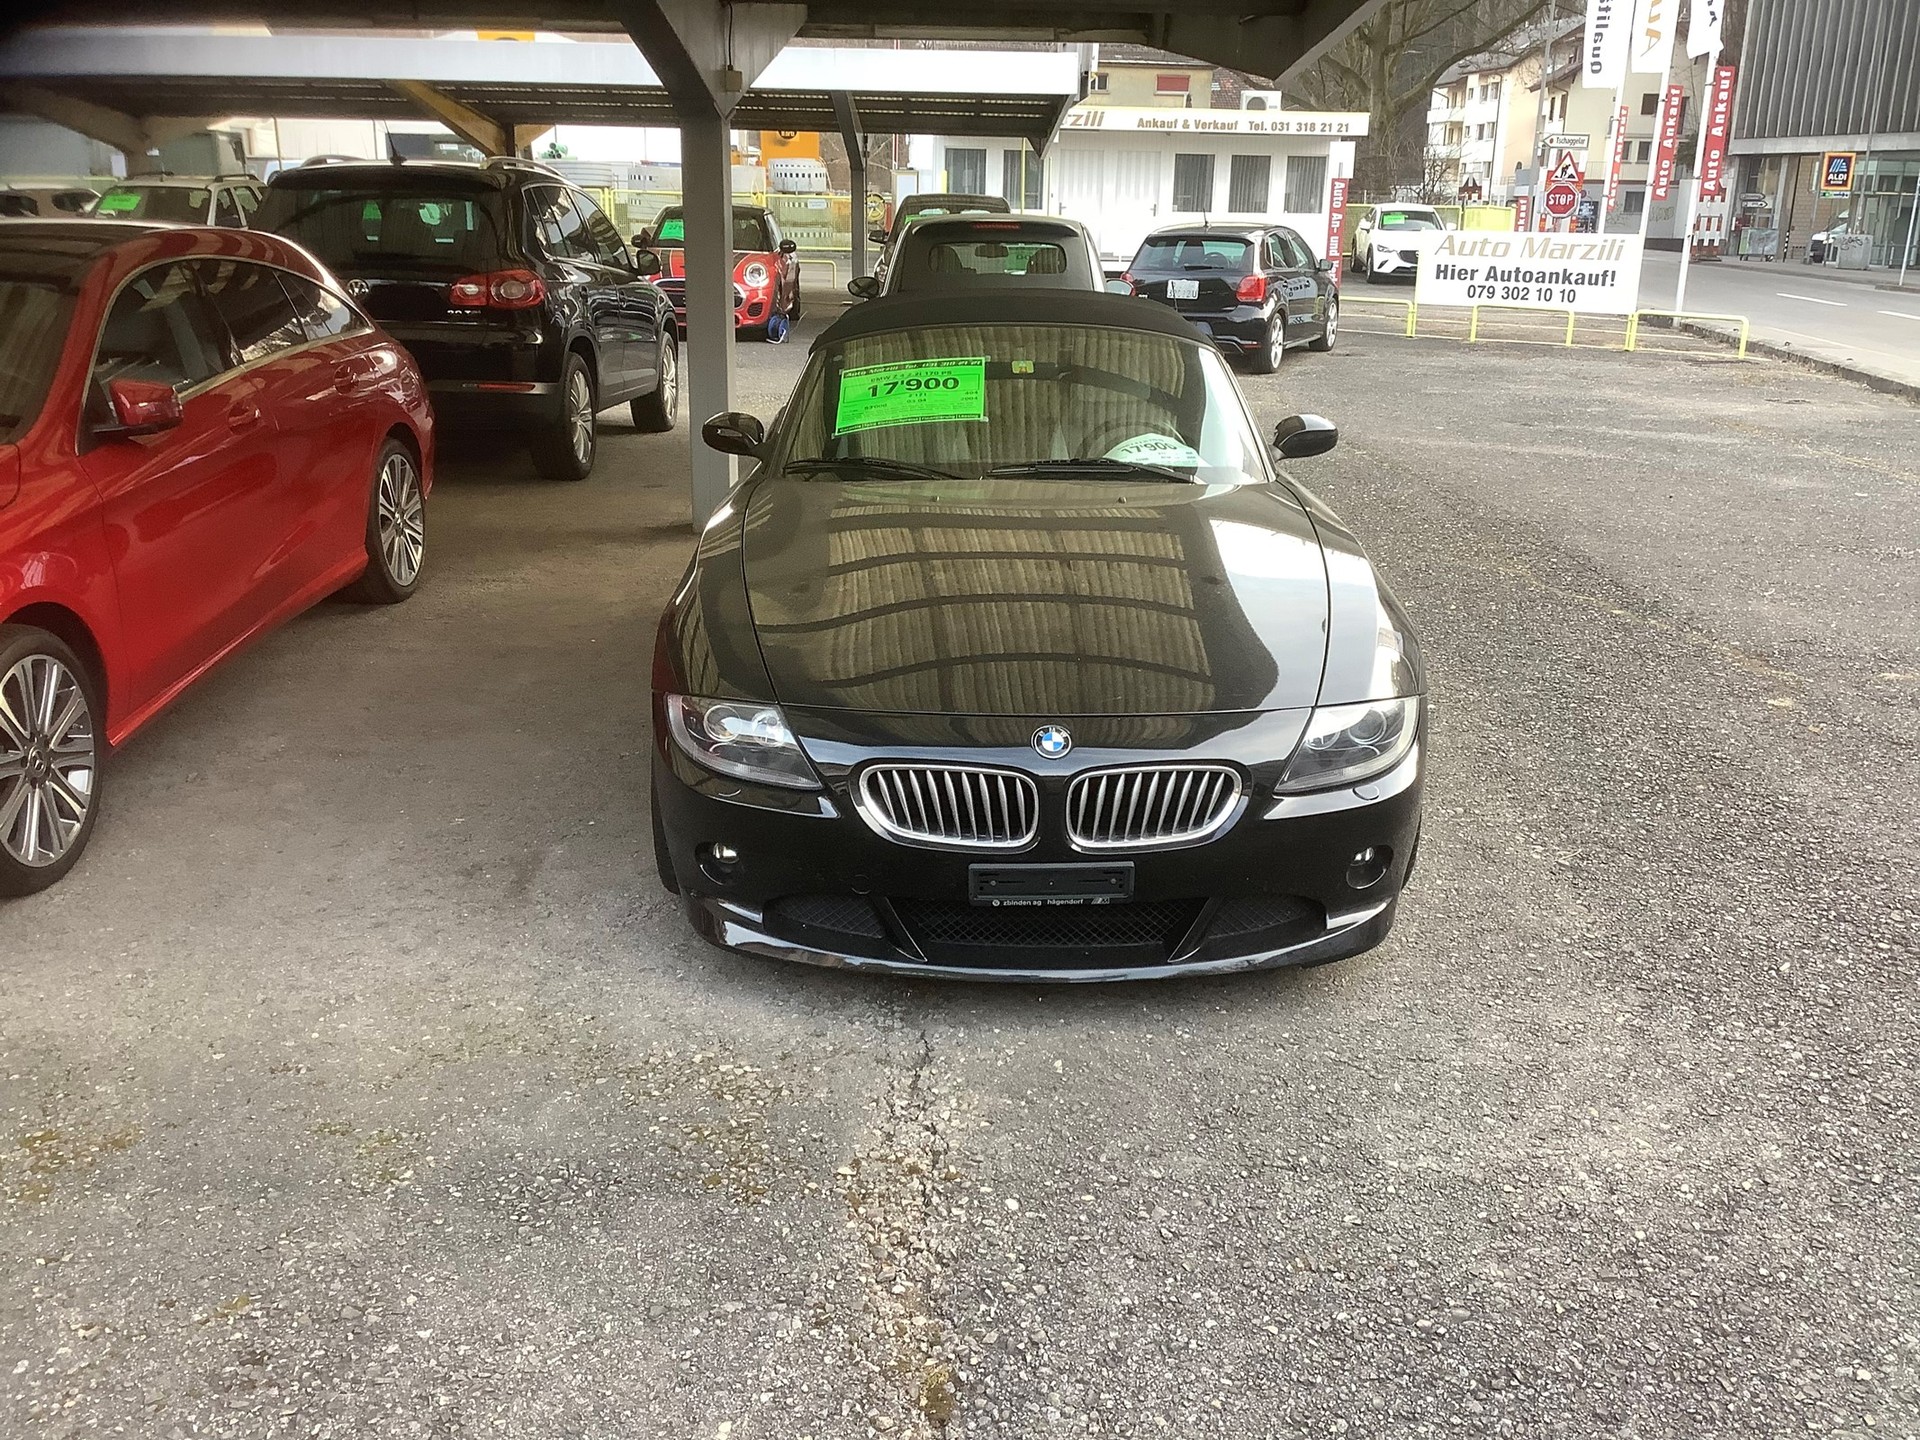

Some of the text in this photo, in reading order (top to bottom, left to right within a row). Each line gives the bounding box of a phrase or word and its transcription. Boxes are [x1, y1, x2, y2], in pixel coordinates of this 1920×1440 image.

[1137, 117, 1349, 133] Ankauf & Verkauf Tel. 031 318 21 21
[1704, 70, 1732, 191] Auto Ankauf
[1655, 159, 1671, 197] Auto
[1663, 88, 1681, 148] Ankauf
[1828, 173, 1848, 181] ALDI
[1332, 181, 1346, 208] Auto
[1548, 194, 1574, 205] STOP
[1331, 213, 1343, 233] An-
[1329, 236, 1340, 257] und
[1434, 235, 1626, 261] Auto Marzili
[1435, 264, 1616, 287] Hier Autoankauf!
[1467, 285, 1576, 303] 079 302 10 10
[868, 377, 960, 398] 17'900
